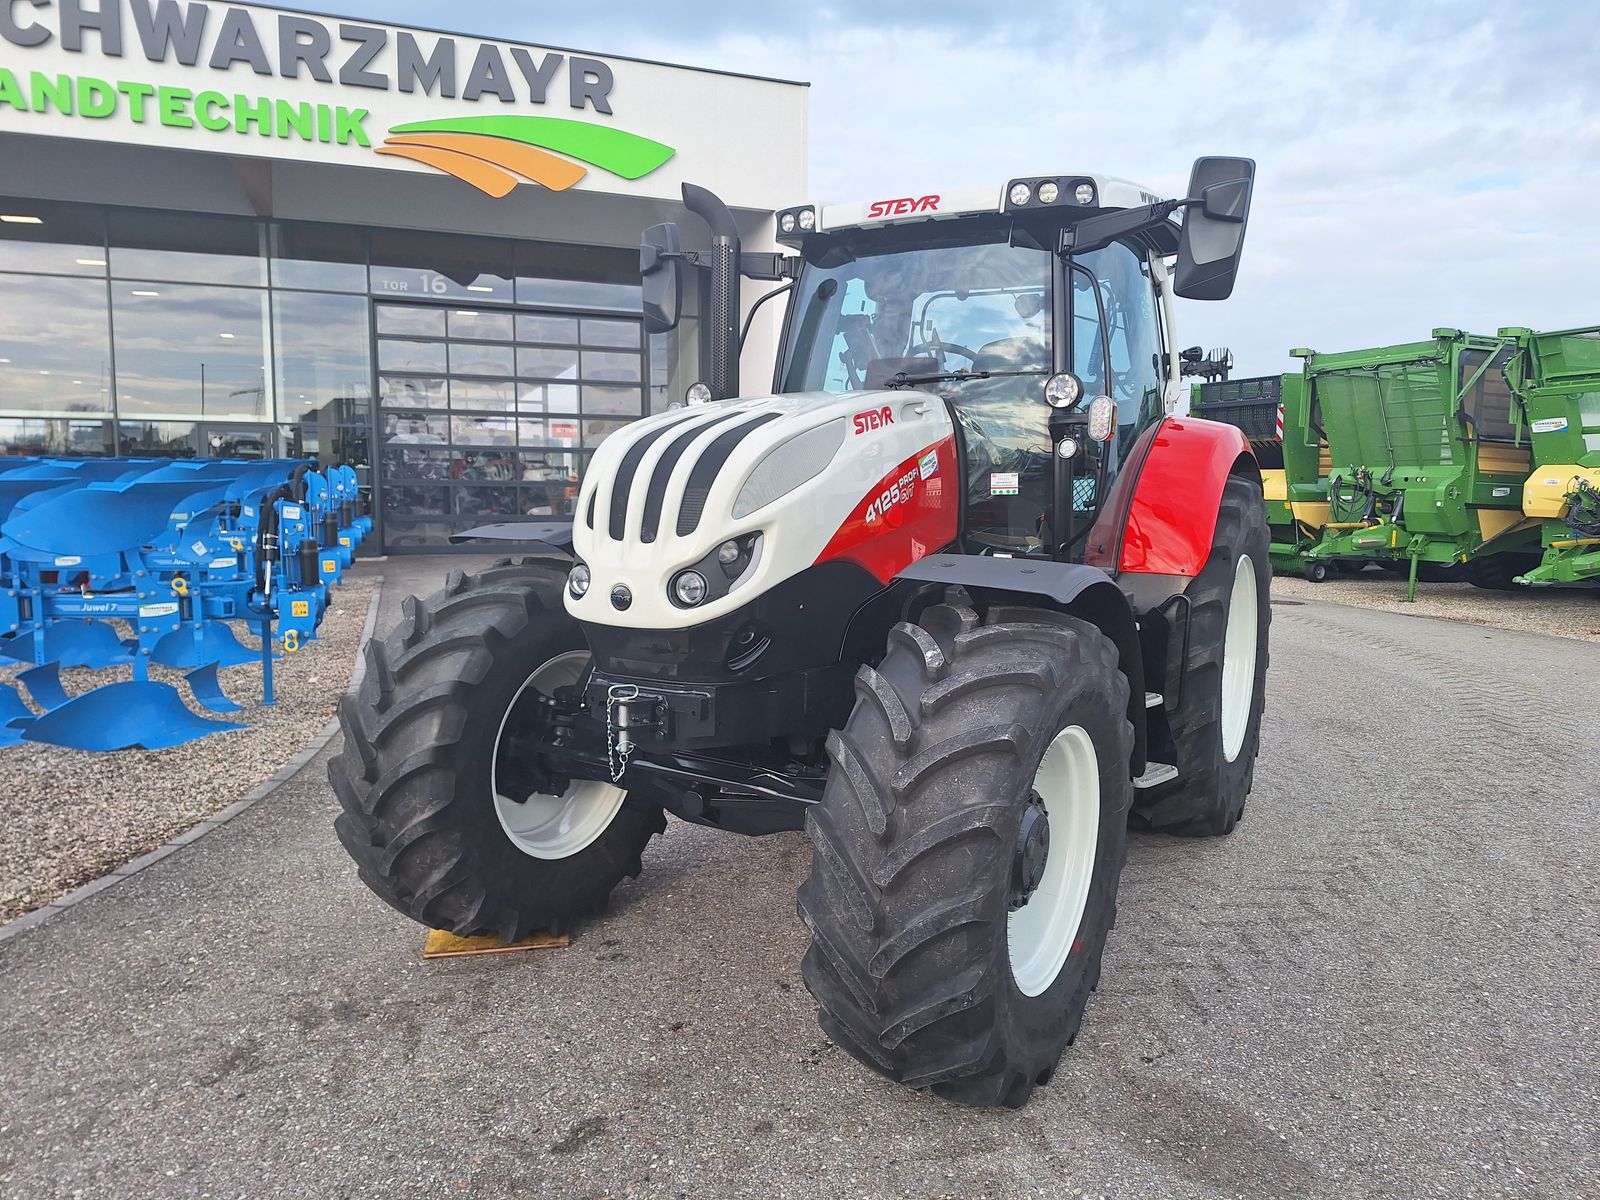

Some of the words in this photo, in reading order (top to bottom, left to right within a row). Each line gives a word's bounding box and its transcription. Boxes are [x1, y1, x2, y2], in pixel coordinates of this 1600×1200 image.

[868, 195, 941, 218] STEYR
[382, 280, 408, 291] TOR
[420, 274, 447, 294] 16
[853, 406, 894, 435] STEYR
[865, 483, 900, 524] 4125
[898, 467, 919, 488] PROFI
[81, 603, 109, 611] Juwel
[110, 603, 118, 611] 7
